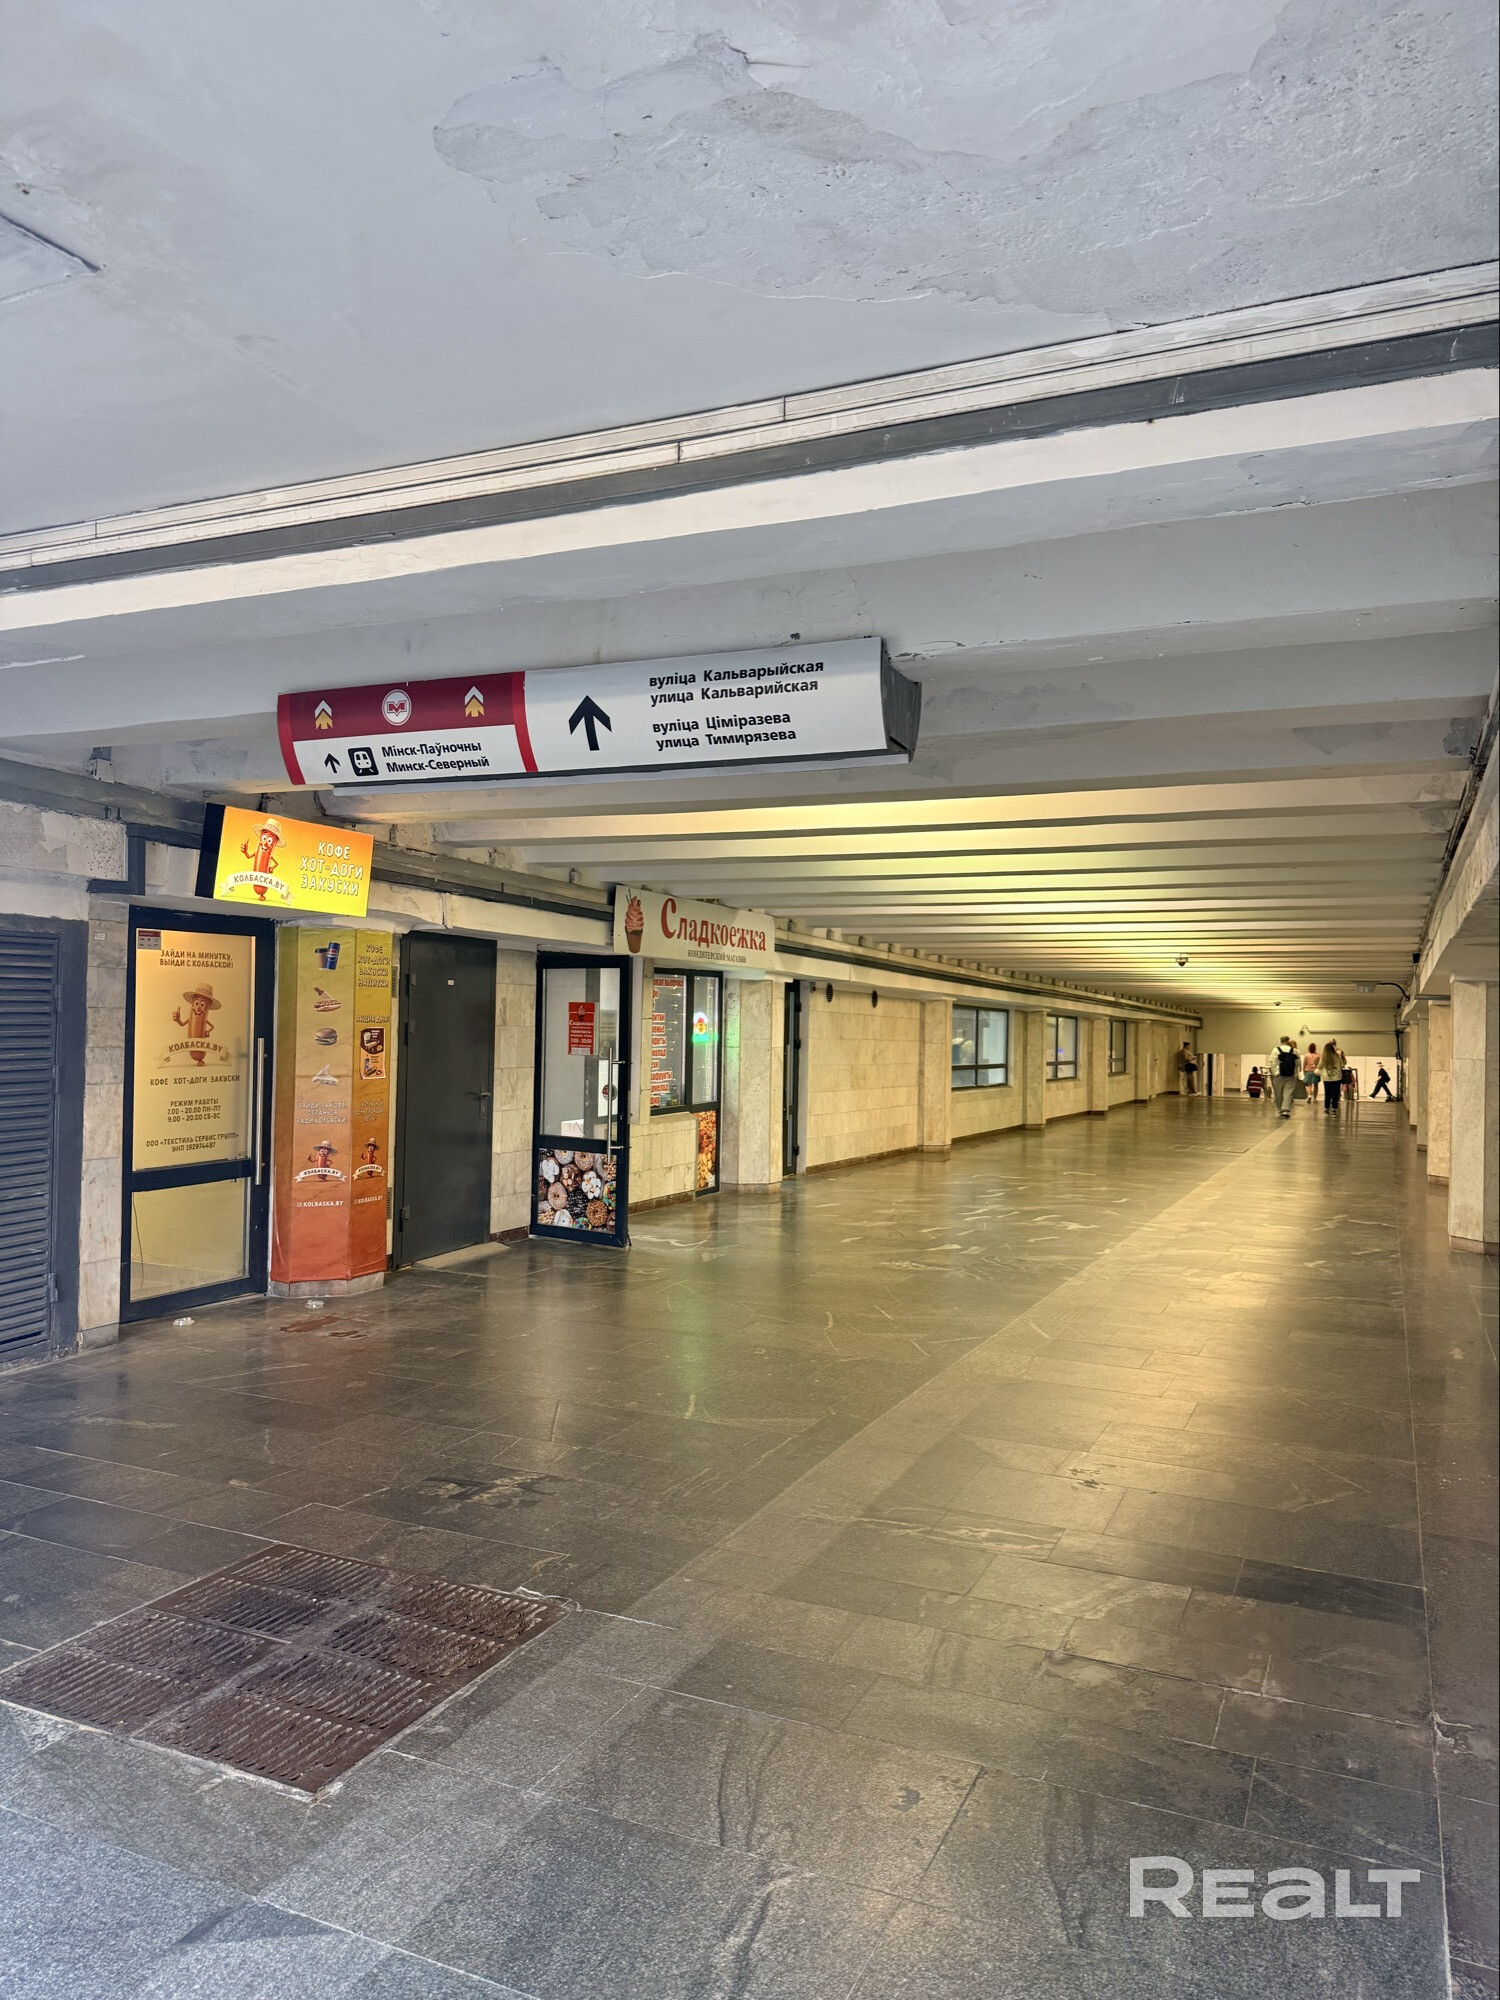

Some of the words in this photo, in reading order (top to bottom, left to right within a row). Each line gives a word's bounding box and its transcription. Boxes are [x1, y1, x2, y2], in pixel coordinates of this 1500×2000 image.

[649, 672, 696, 689] вуліца
[703, 662, 824, 682] Кальварыйская
[650, 691, 694, 707] улица
[701, 680, 819, 700] Кальварийская
[652, 719, 700, 736] вуліца
[705, 713, 791, 730] Ціміразева
[381, 742, 482, 757] Мінск-Паўночны
[656, 737, 700, 751] улица
[705, 730, 797, 745] Тимирязева
[386, 756, 490, 773] Минск-Северный
[318, 841, 351, 860] КОФЕ
[300, 856, 364, 880] ХОТ-ДОГИ
[300, 874, 360, 896] ЗАКУСКИ
[660, 898, 767, 952] Сладкоежка
[160, 949, 185, 958] ЗАЙДИ
[186, 951, 197, 959] НА
[159, 958, 185, 967] ВЫЙДИ
[192, 960, 234, 969] КОЛБАСКОЙ!
[150, 1078, 169, 1086] КОФЕ
[173, 1076, 208, 1085] ХОТ-ДОГИ
[210, 1074, 240, 1083] ЗАКУСКИ
[194, 1098, 219, 1106] РАБОТЫ
[194, 1134, 216, 1143] СЕРВИС
[303, 1200, 344, 1208] KOLBASKA.BY
